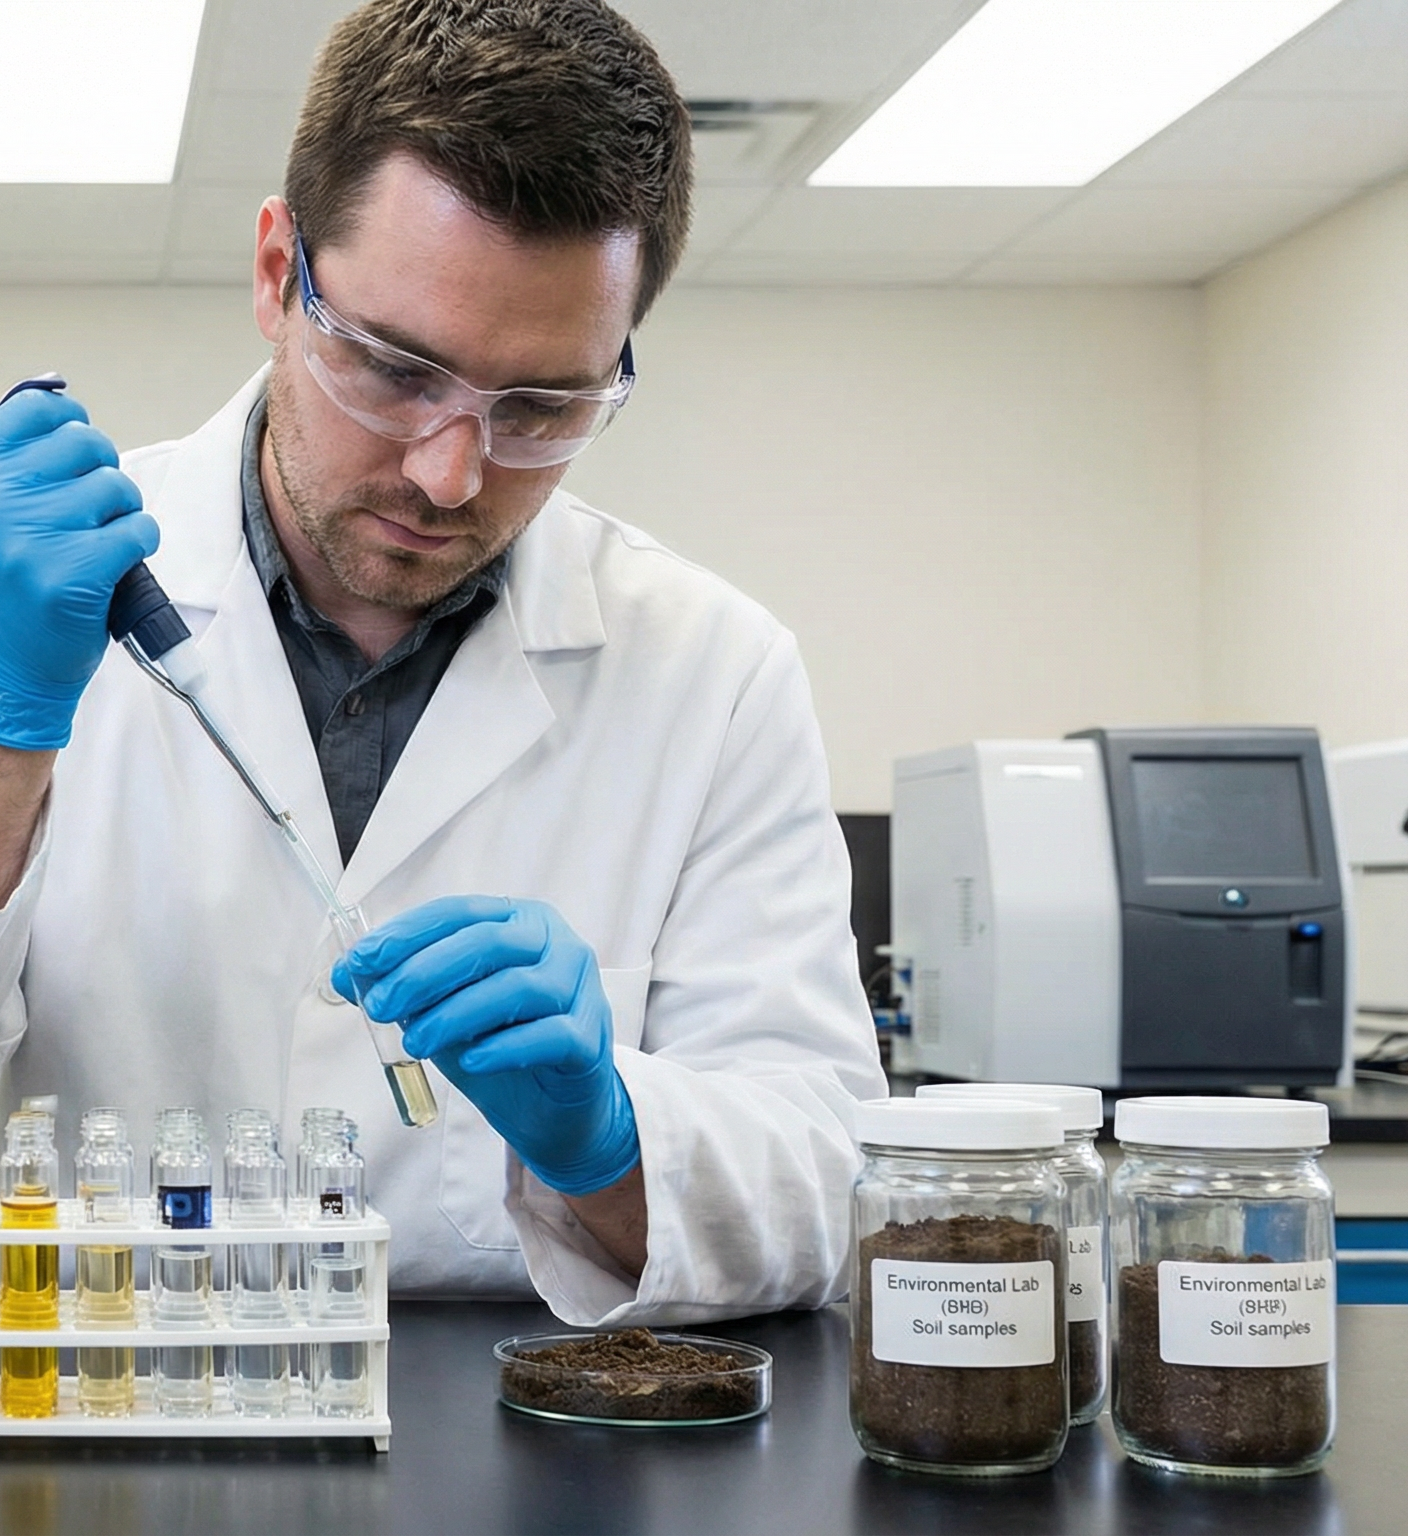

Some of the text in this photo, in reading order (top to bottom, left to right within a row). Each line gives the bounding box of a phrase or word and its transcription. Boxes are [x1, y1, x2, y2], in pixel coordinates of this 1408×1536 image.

[887, 1274, 1040, 1293] Environmental Lab
[1179, 1274, 1327, 1293] Environmental Lab
[912, 1319, 1018, 1339] Soil samples
[1210, 1320, 1311, 1339] Soil samples
